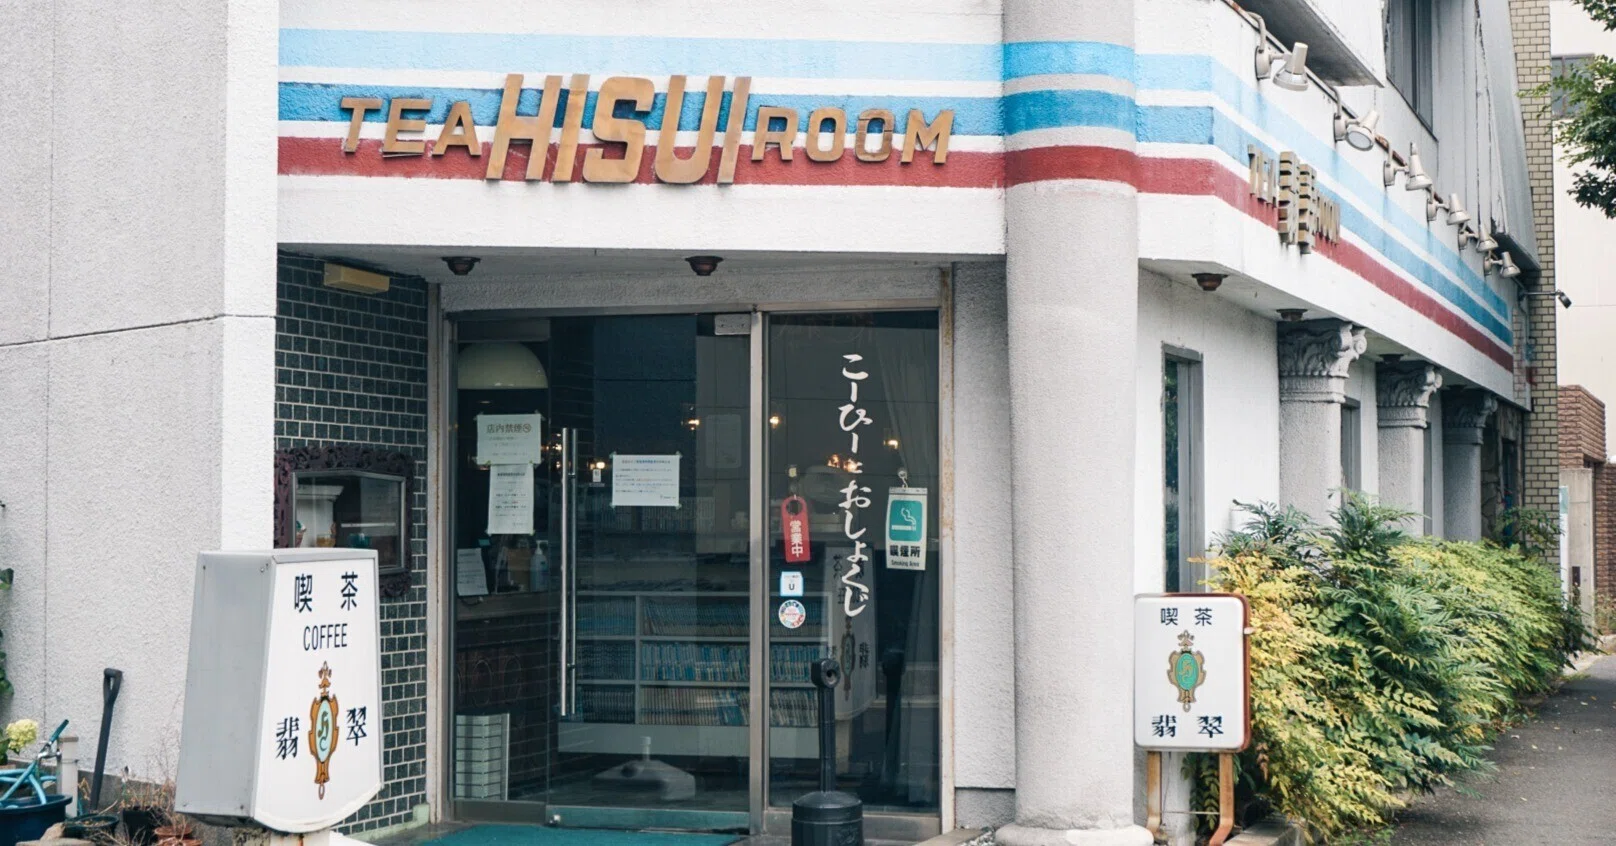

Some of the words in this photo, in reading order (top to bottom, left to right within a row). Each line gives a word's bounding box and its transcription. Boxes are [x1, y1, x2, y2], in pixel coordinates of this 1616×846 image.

[340, 97, 482, 158] TEA
[486, 73, 752, 185] HISUI
[751, 106, 955, 165] ROOM
[294, 571, 358, 613] 喫茶
[1160, 607, 1213, 626] 喫茶
[303, 623, 348, 651] COFFEE
[1151, 714, 1224, 738] 翡翠
